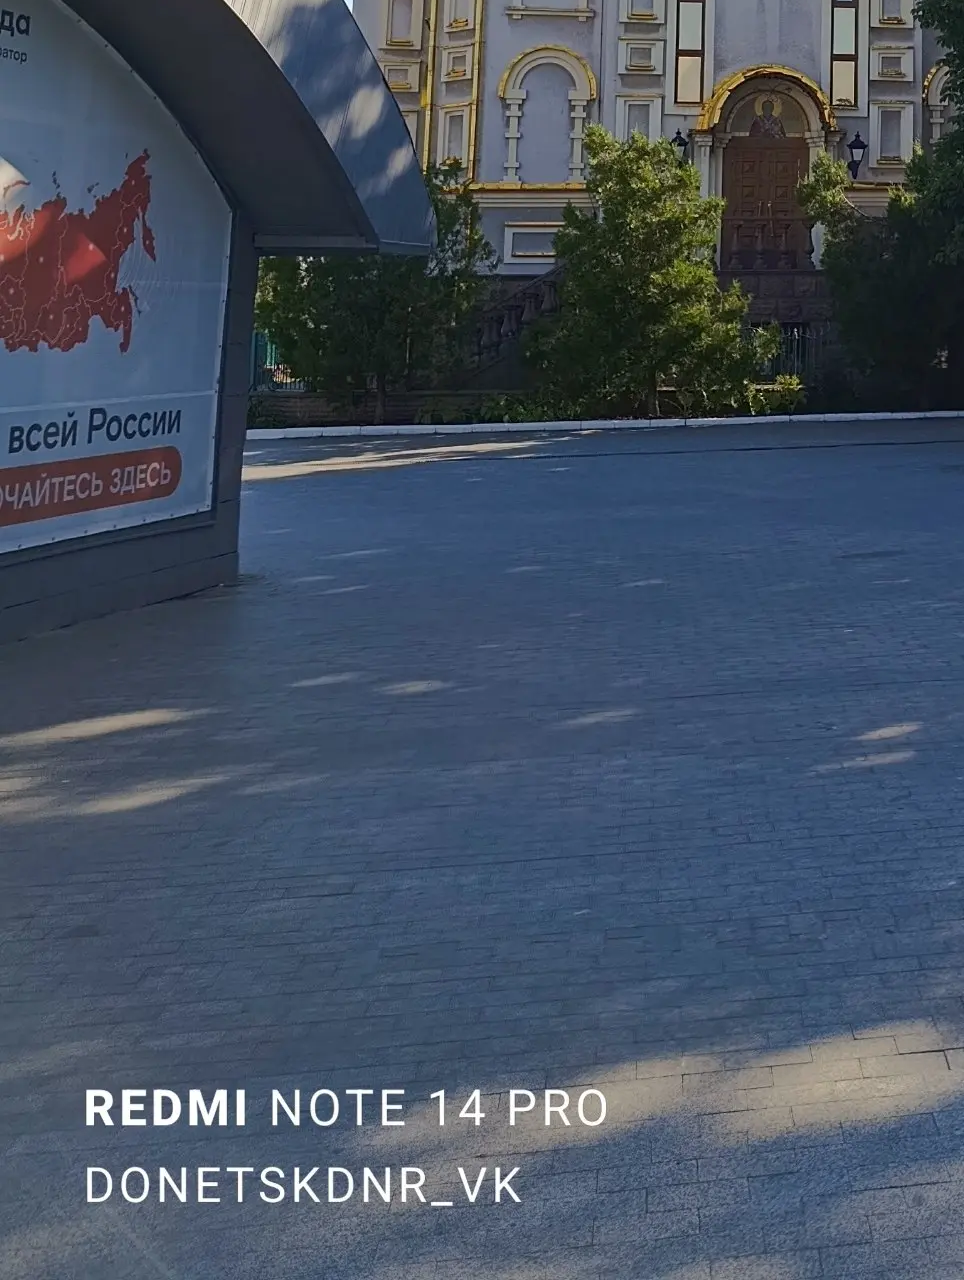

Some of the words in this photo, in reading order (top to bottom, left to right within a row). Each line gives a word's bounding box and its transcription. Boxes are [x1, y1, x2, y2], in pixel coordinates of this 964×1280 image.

[8, 411, 78, 454] всей
[87, 407, 182, 445] России
[0, 472, 104, 510] ЧАЙТЕСЬ
[109, 461, 171, 496] ЗДЕСЬ
